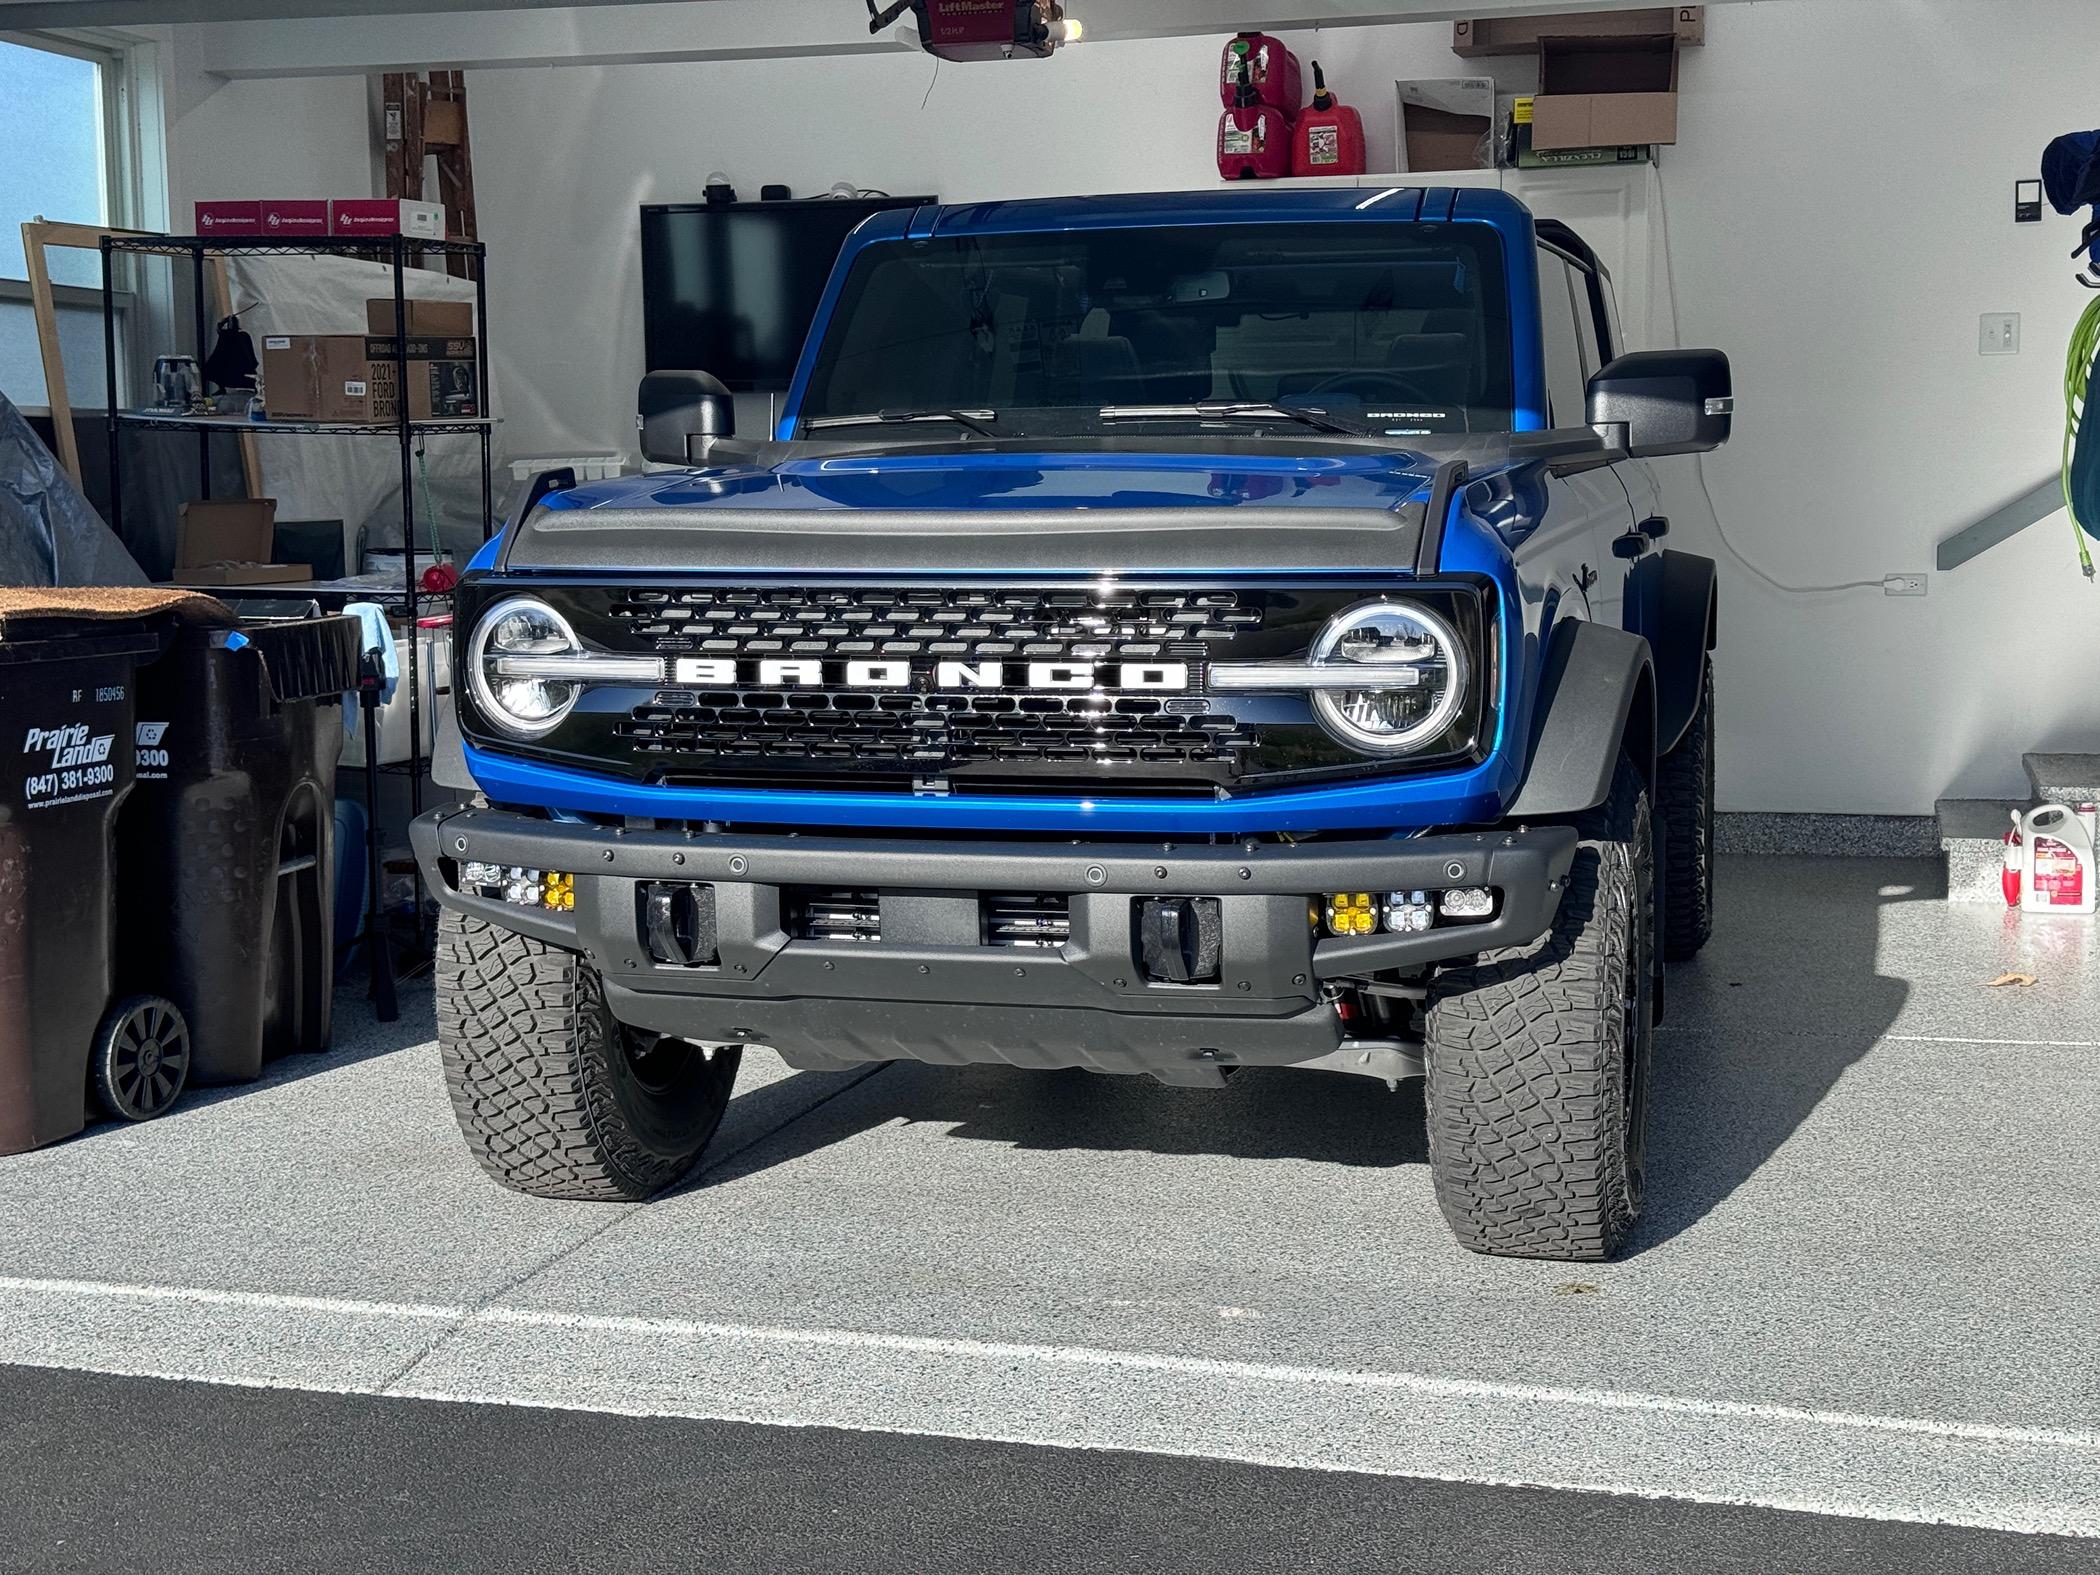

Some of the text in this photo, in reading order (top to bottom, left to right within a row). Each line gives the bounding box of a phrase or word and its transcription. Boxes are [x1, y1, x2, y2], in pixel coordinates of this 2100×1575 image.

[939, 1, 1004, 13] LiftMaster
[372, 381, 395, 399] FORD
[373, 400, 401, 417] BRON
[675, 657, 1189, 691] BRONCO
[23, 722, 89, 753] Prairie
[51, 736, 98, 769] Land
[26, 763, 114, 800] (847) 381-9300
